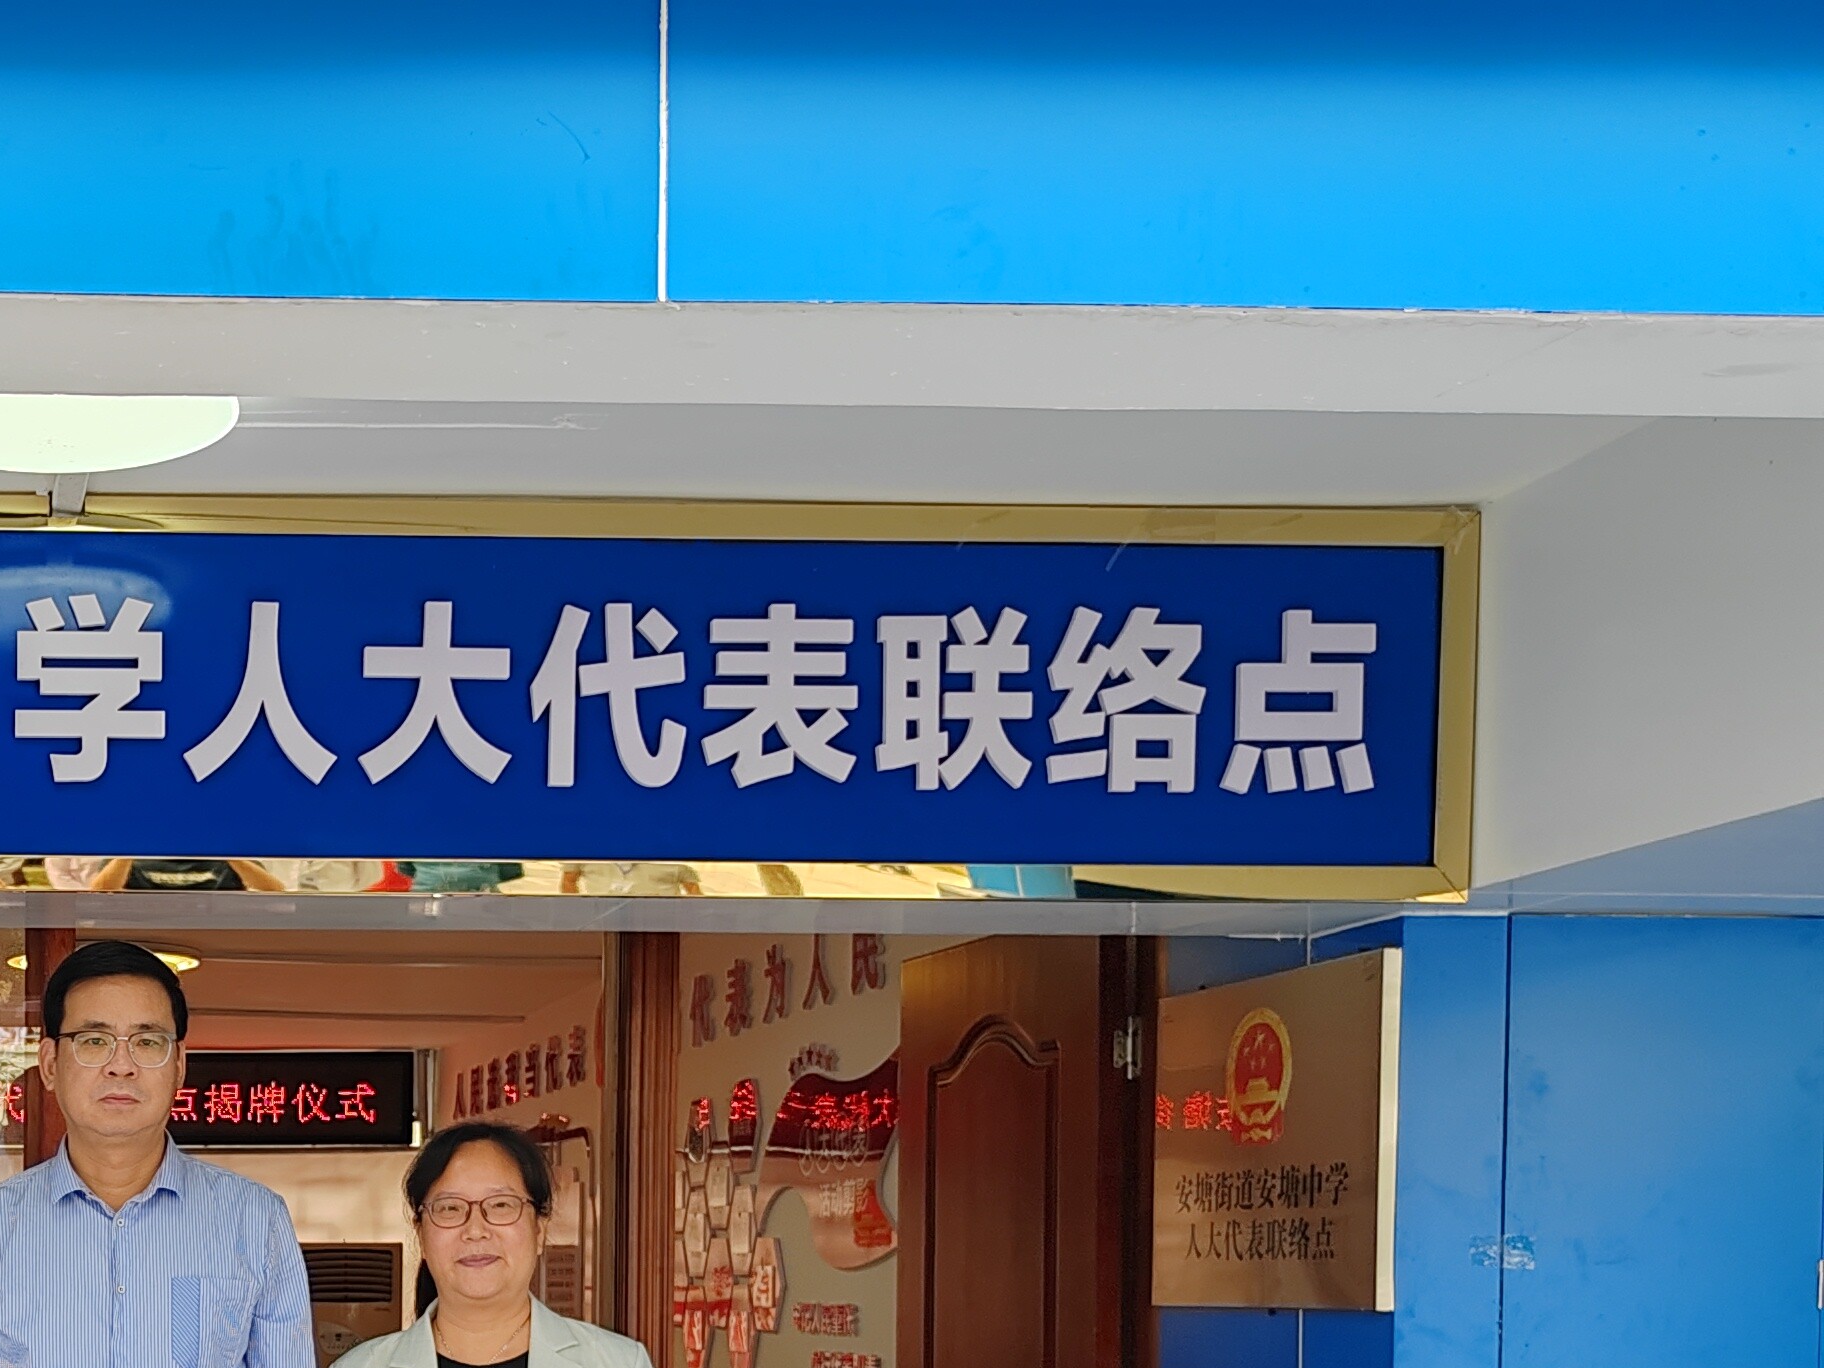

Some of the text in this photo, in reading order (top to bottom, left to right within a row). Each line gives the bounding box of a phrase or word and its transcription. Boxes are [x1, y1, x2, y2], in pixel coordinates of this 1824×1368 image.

[690, 933, 882, 1048] 代表为人民
[172, 1081, 376, 1123] 点揭牌仪式
[1176, 1162, 1349, 1214] 安塘街道安塘中学
[1186, 1217, 1335, 1261] 人大代表联络点
